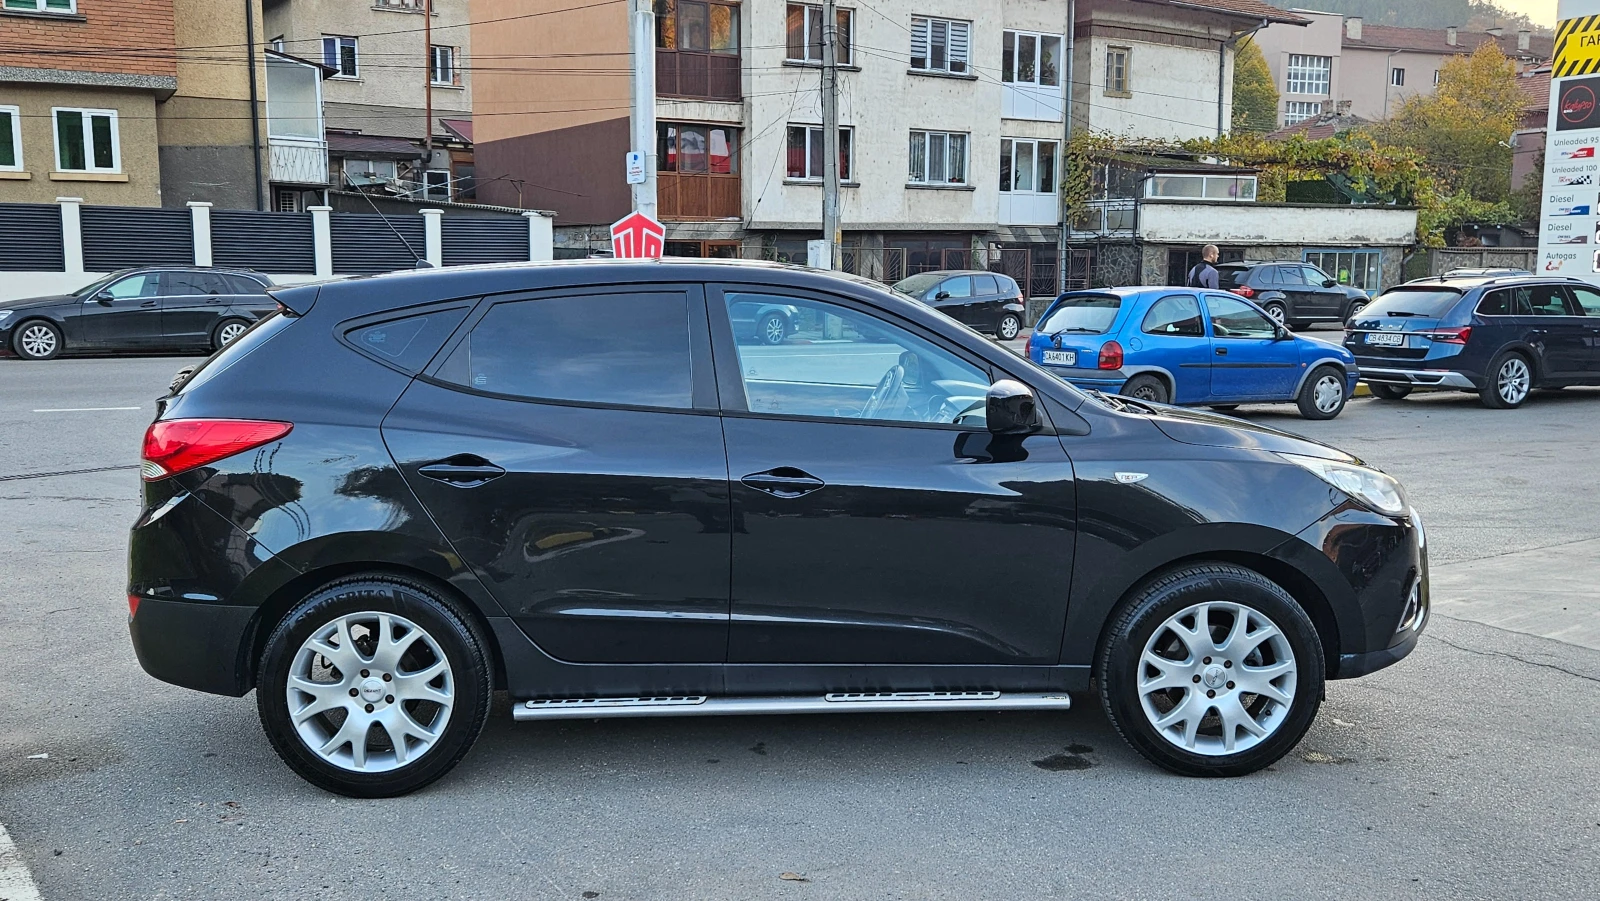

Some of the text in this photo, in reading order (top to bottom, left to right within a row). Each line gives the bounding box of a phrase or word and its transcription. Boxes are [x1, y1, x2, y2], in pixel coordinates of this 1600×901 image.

[1554, 137, 1588, 146] Unleaded
[1552, 165, 1583, 173] Unleaded
[1549, 194, 1574, 203] Diesel
[1547, 223, 1572, 231] Diesel
[1546, 252, 1576, 261] Autogas
